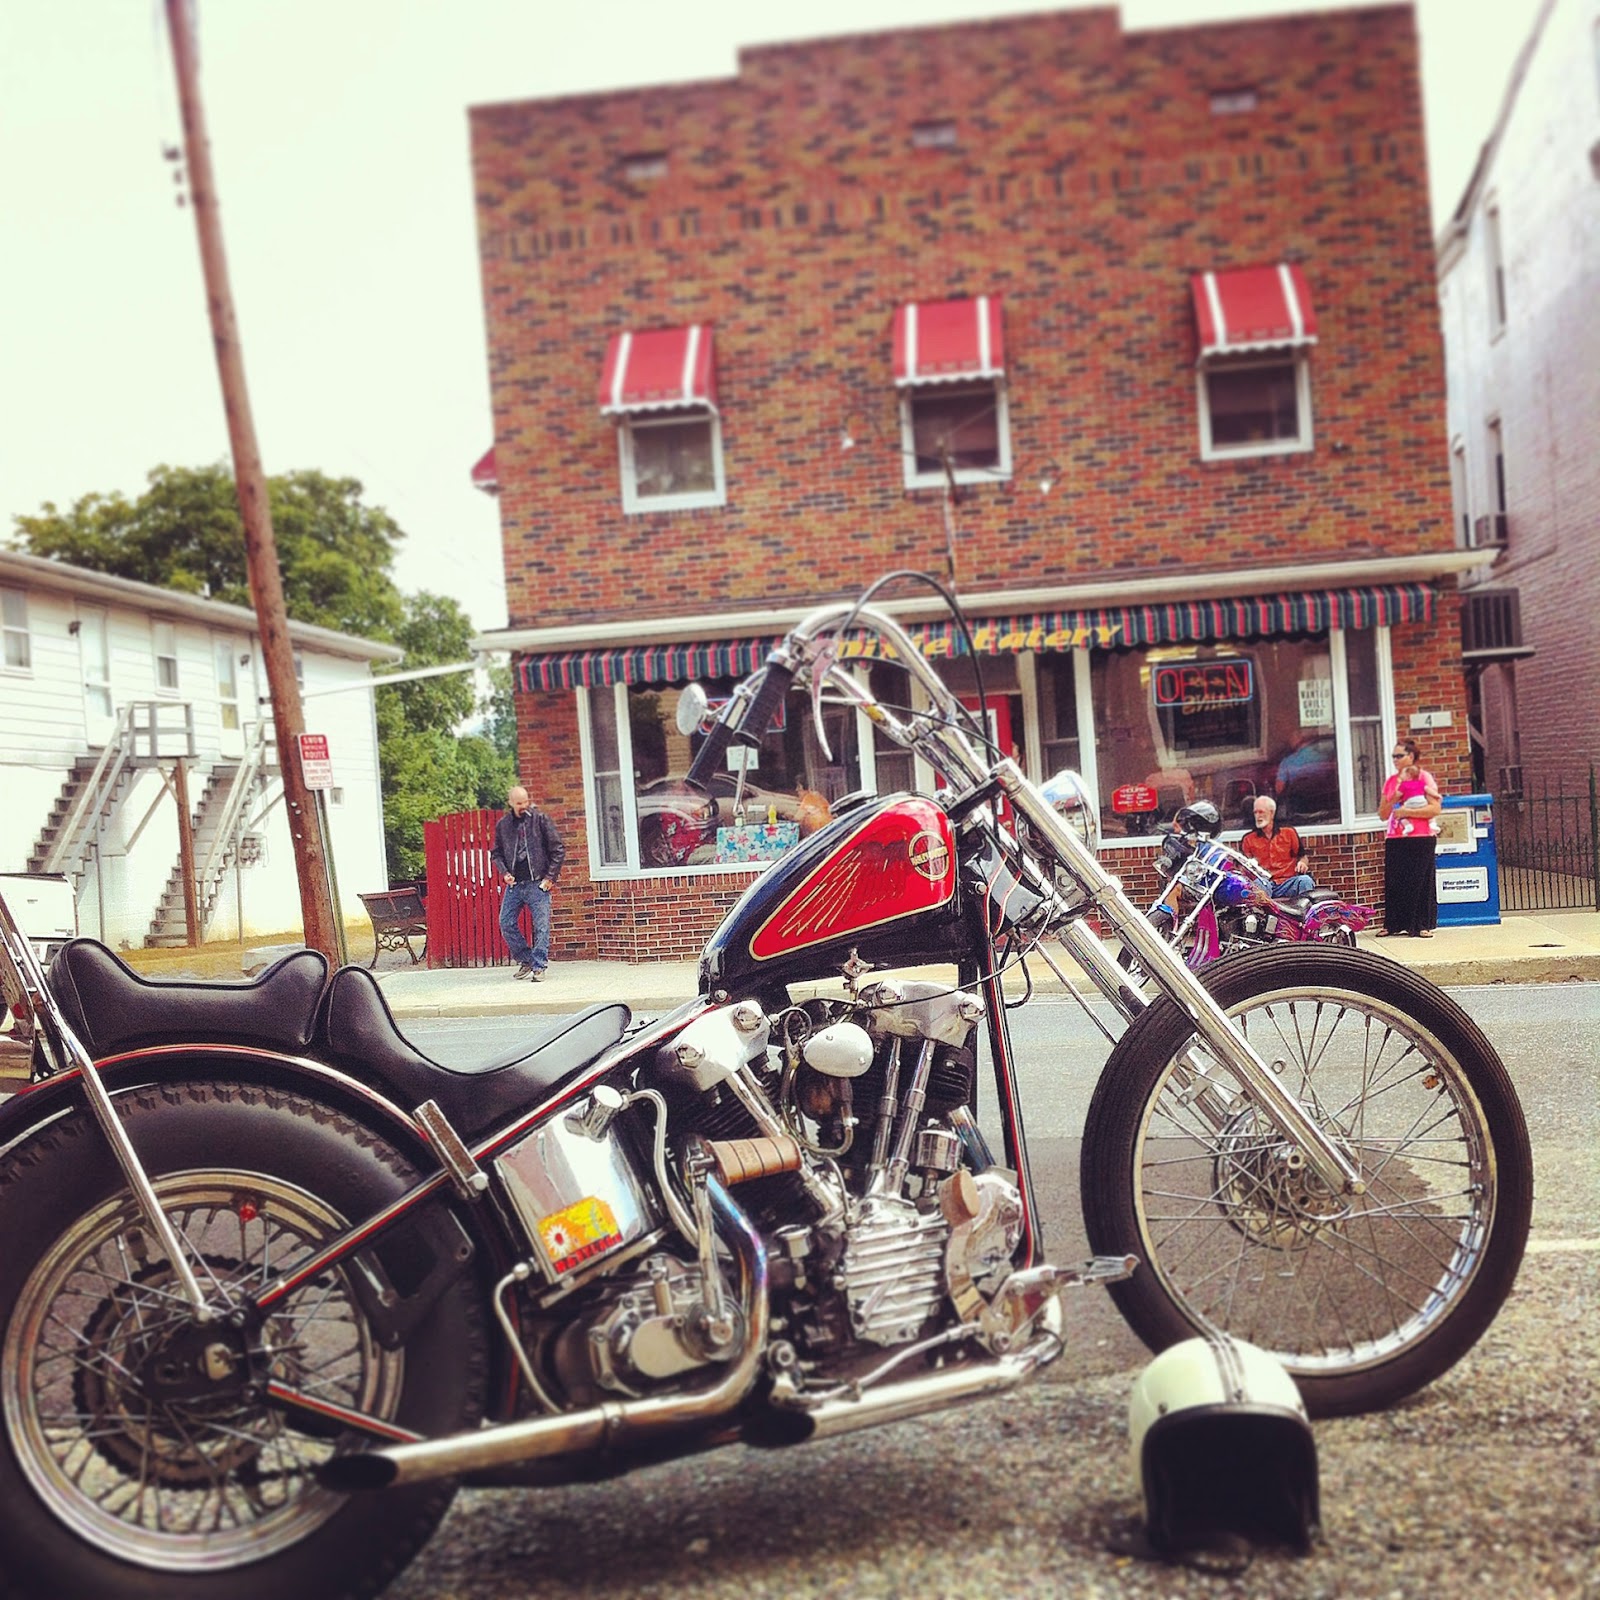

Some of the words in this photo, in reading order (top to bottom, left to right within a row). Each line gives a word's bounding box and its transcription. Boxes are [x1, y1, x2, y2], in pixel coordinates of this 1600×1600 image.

[1157, 664, 1249, 702] OPEN
[1300, 690, 1330, 699] WANTED
[1425, 714, 1432, 727] 4
[303, 736, 324, 744] SNOW
[304, 751, 327, 759] ROUTE
